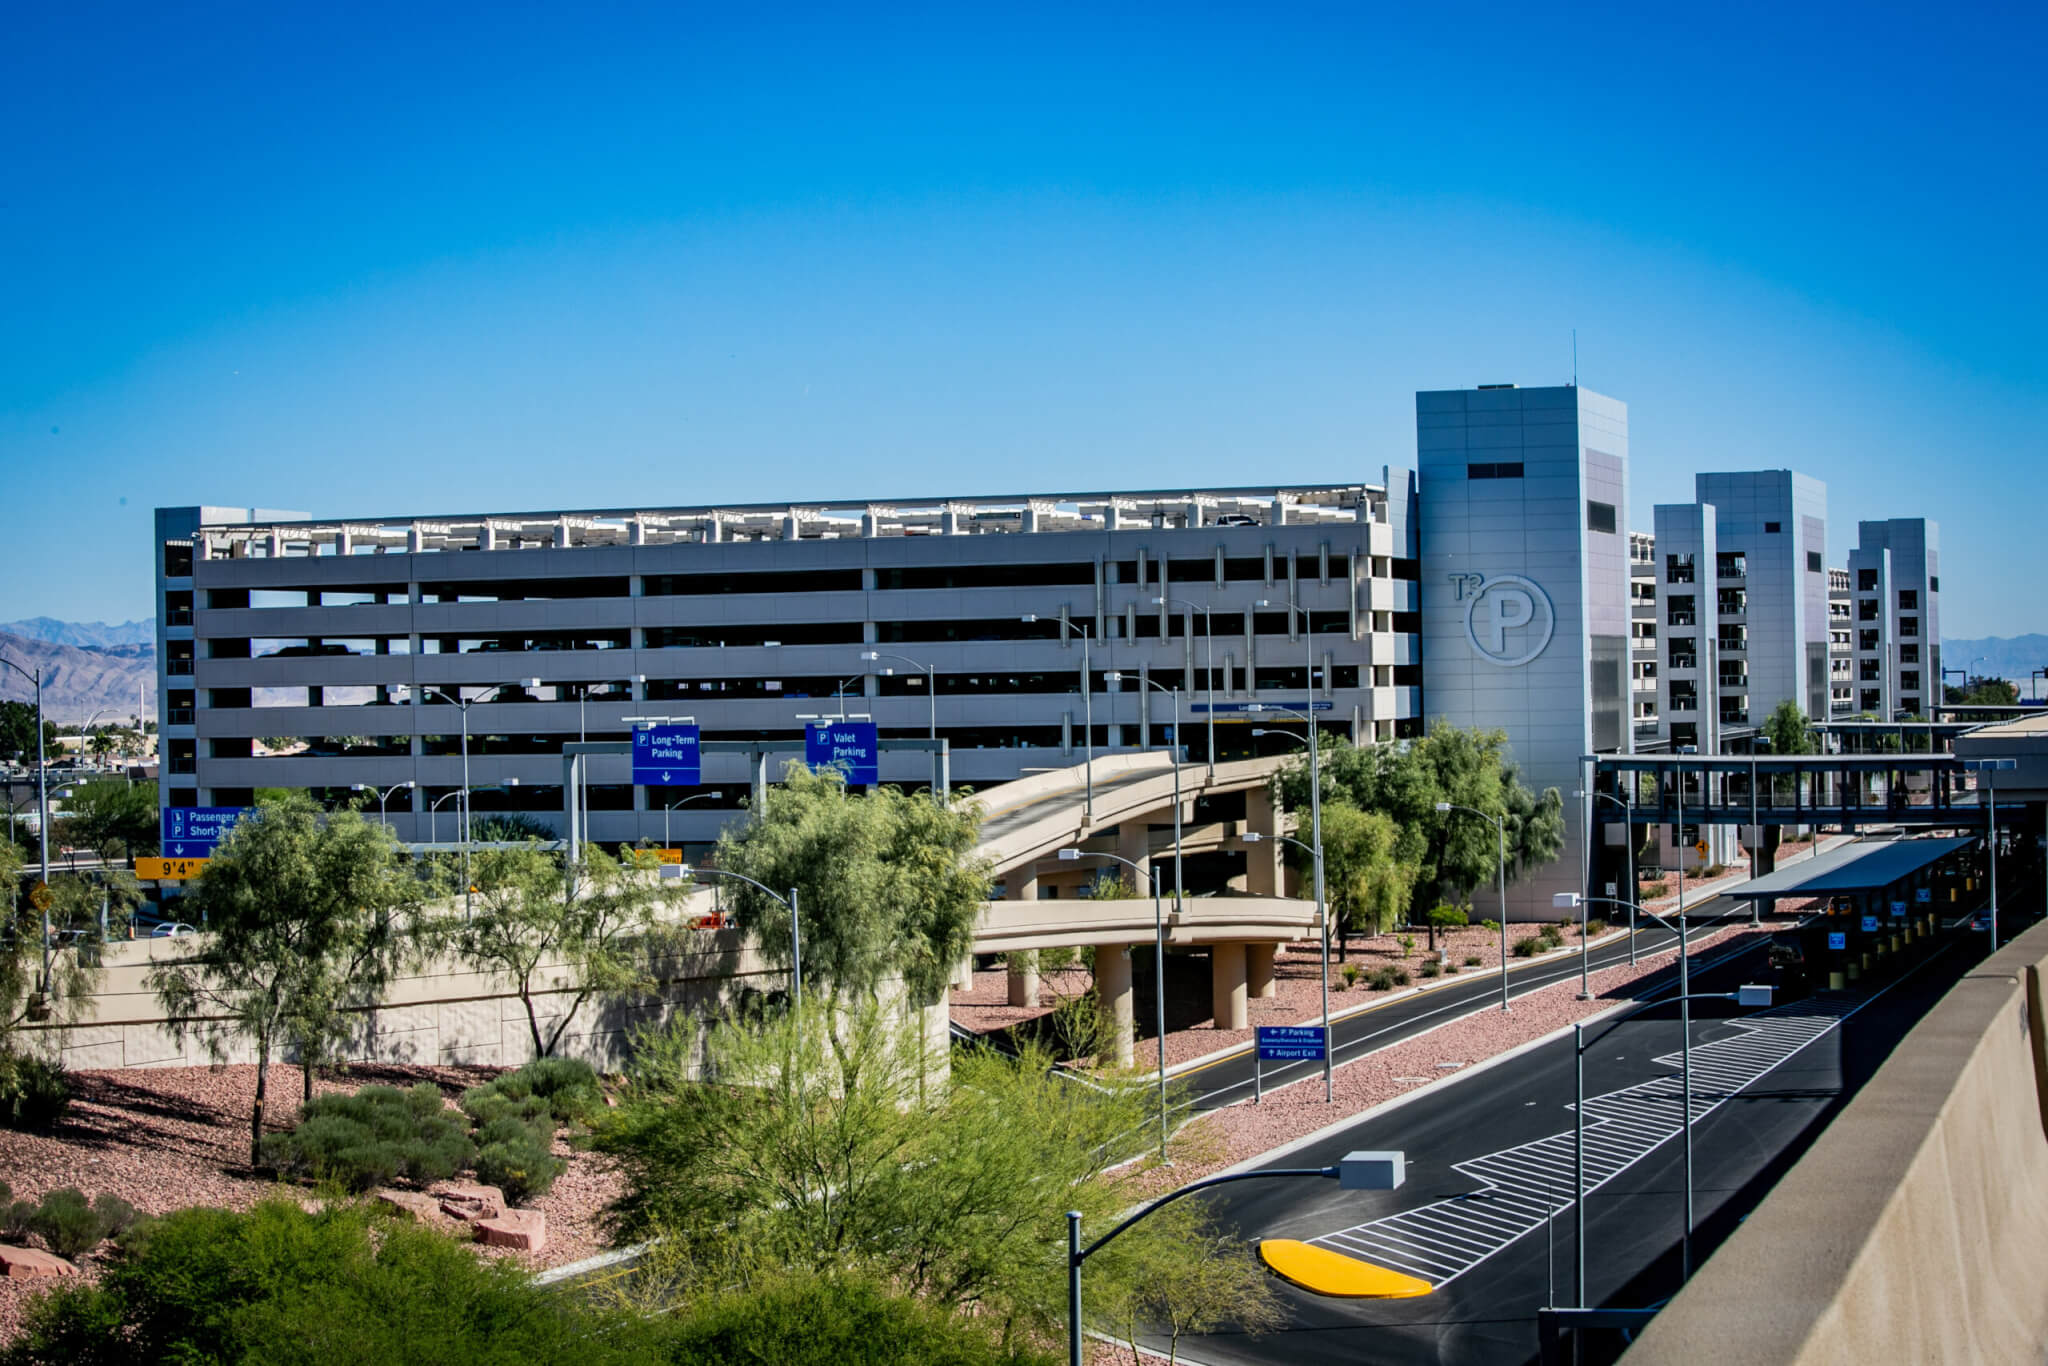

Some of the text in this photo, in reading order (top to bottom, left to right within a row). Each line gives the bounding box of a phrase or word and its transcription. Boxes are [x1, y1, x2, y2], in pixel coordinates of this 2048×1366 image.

[1448, 573, 1485, 600] T3
[1489, 589, 1535, 653] P
[651, 734, 695, 746] Long-Term
[833, 733, 856, 743] Valet
[651, 748, 683, 760] Parking
[833, 746, 866, 758] Parking
[189, 812, 235, 823] Passenger
[162, 861, 194, 875] 9'4"
[1288, 1029, 1314, 1037] Parking
[1276, 1049, 1300, 1058] Airport
